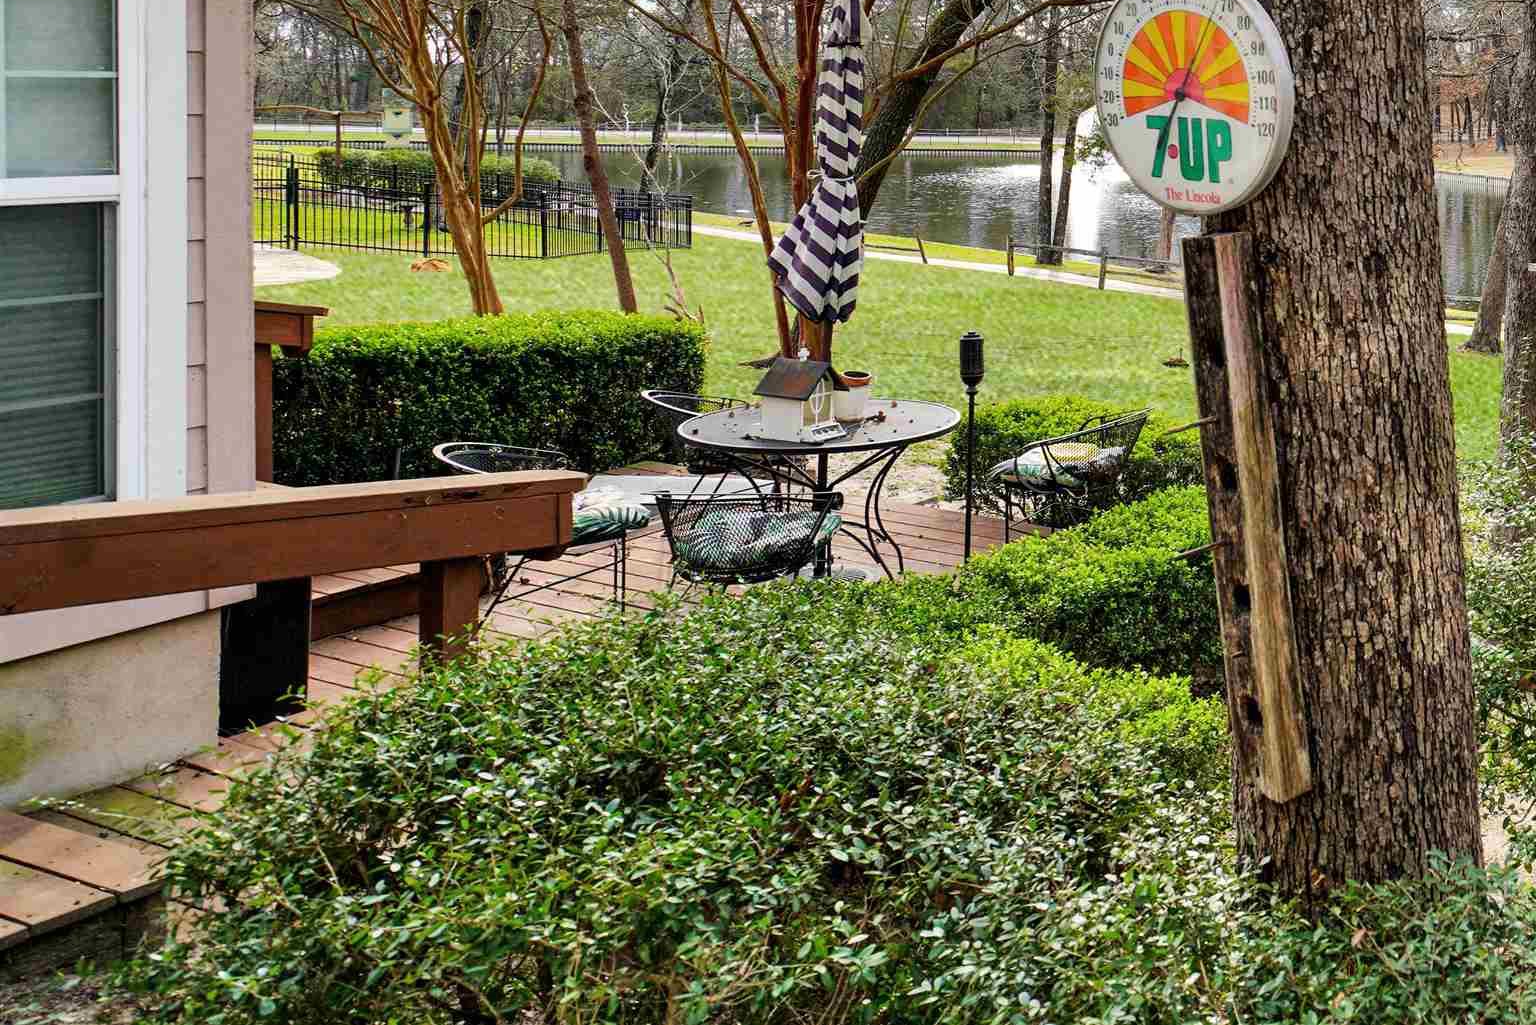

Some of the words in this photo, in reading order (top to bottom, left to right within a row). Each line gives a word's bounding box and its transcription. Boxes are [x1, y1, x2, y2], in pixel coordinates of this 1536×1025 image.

[1126, 2, 1137, 17] 20
[1113, 21, 1124, 35] 10
[1237, 15, 1251, 31] 80
[1107, 42, 1114, 57] 0
[1250, 40, 1265, 57] 90
[1256, 69, 1276, 85] 100
[1258, 96, 1278, 114] 110
[1256, 122, 1275, 138] 120
[1165, 185, 1184, 201] The
